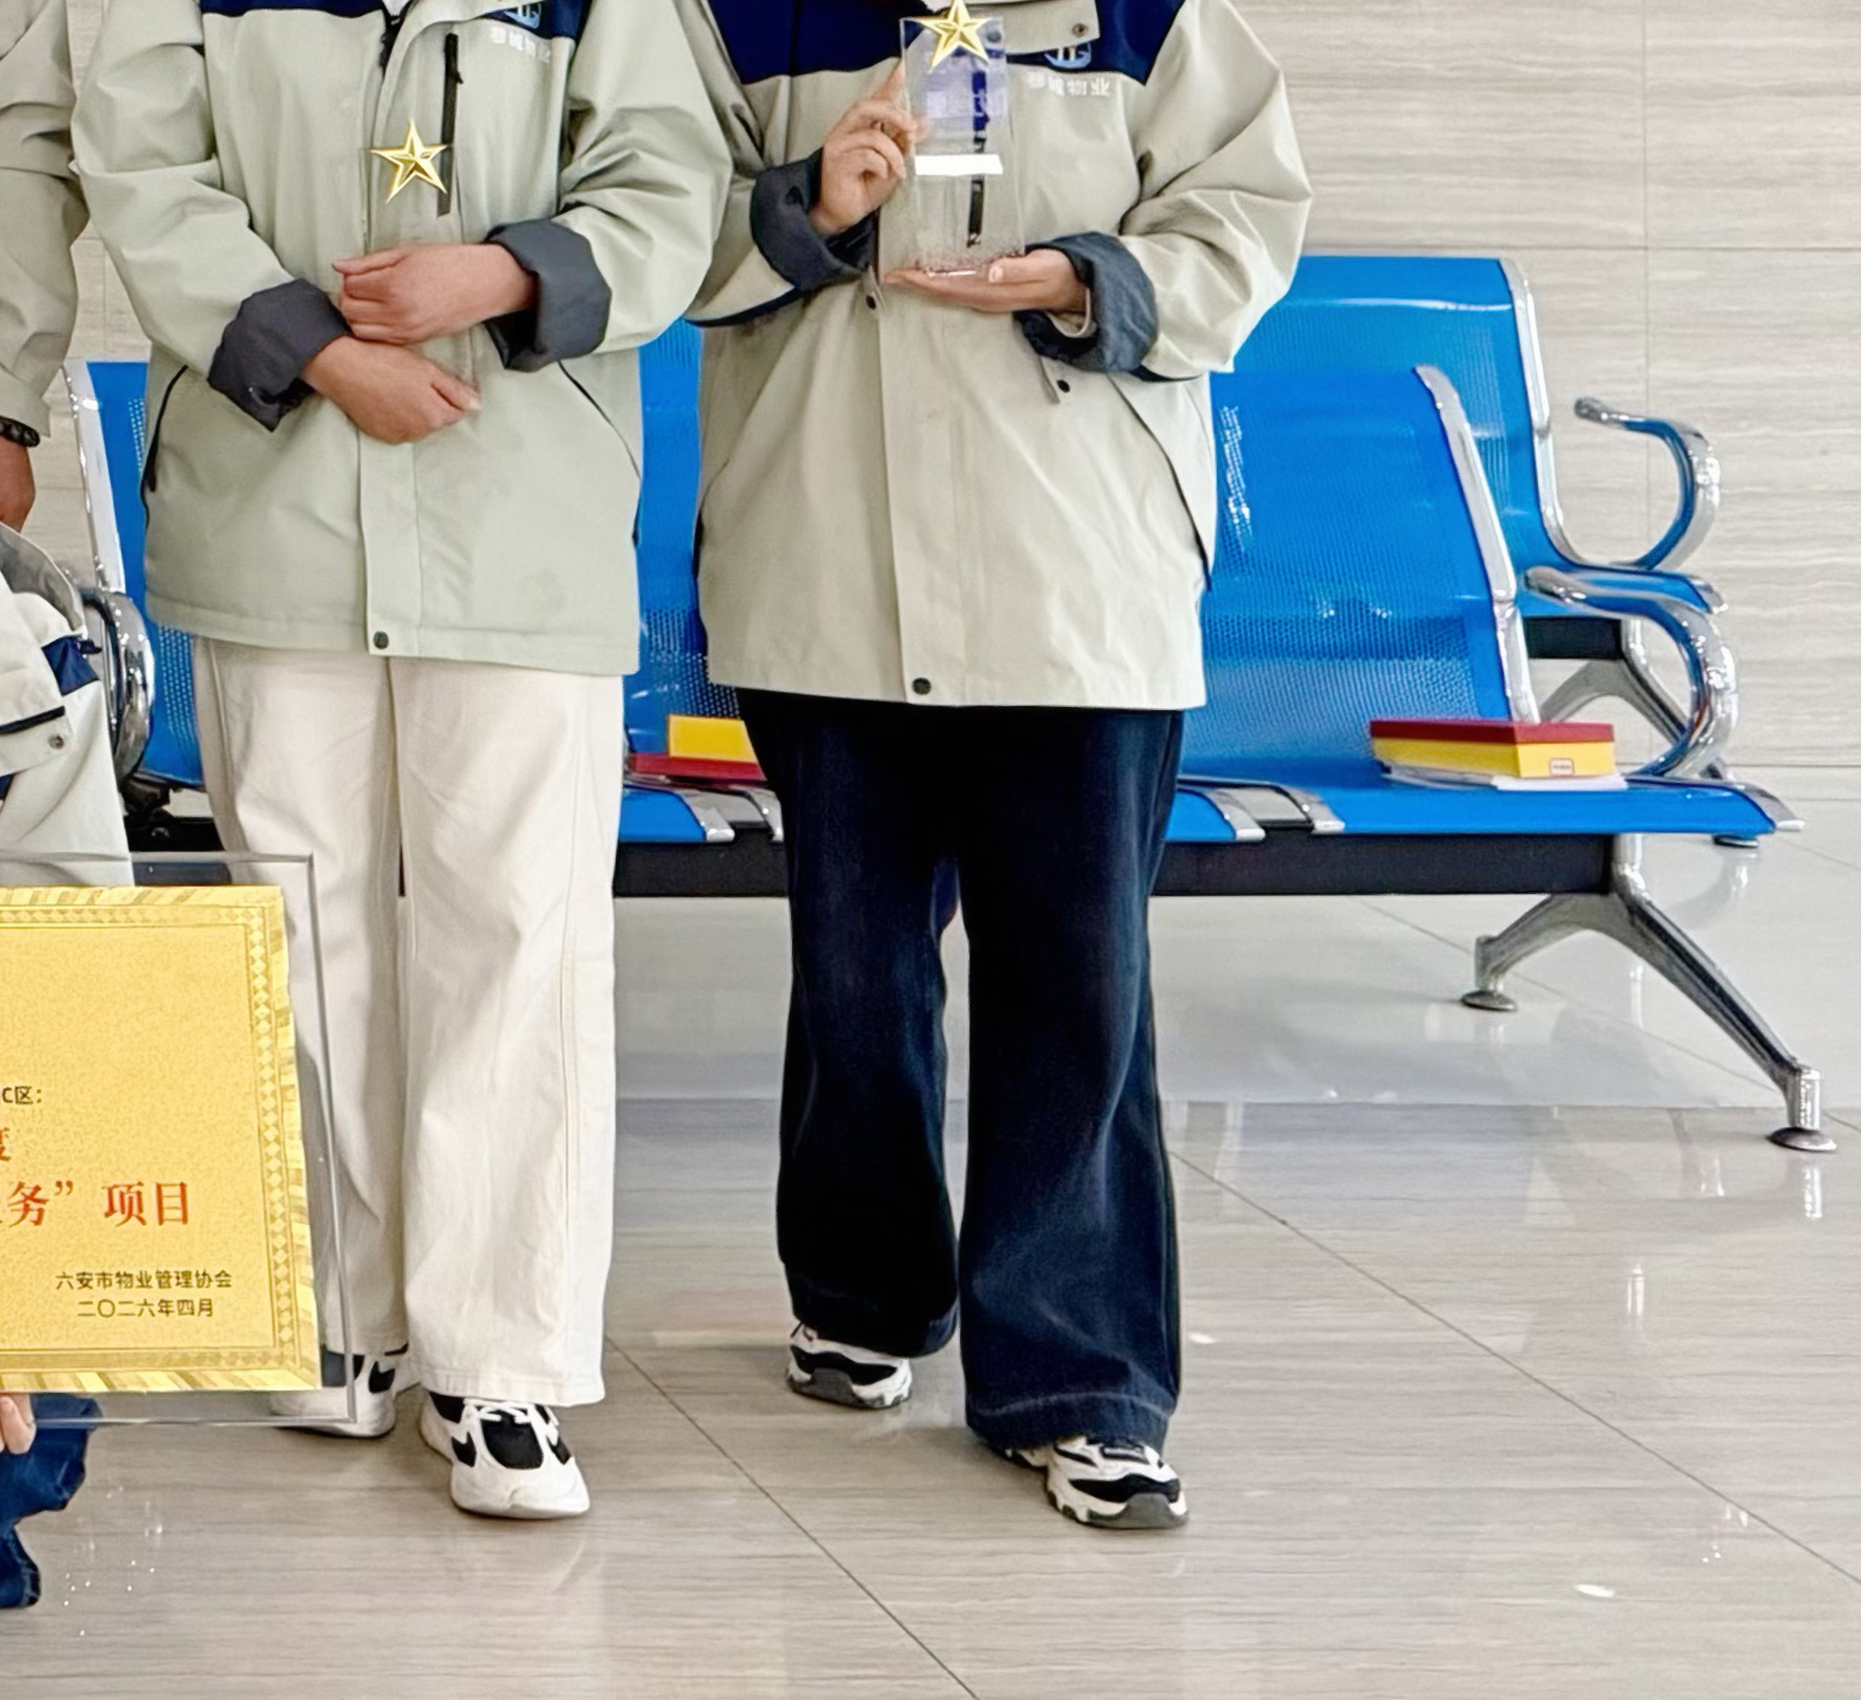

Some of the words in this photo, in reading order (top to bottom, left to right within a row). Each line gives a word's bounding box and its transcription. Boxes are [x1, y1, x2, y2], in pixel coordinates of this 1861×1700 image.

[55, 1270, 234, 1291] 六安市物业管理协会
